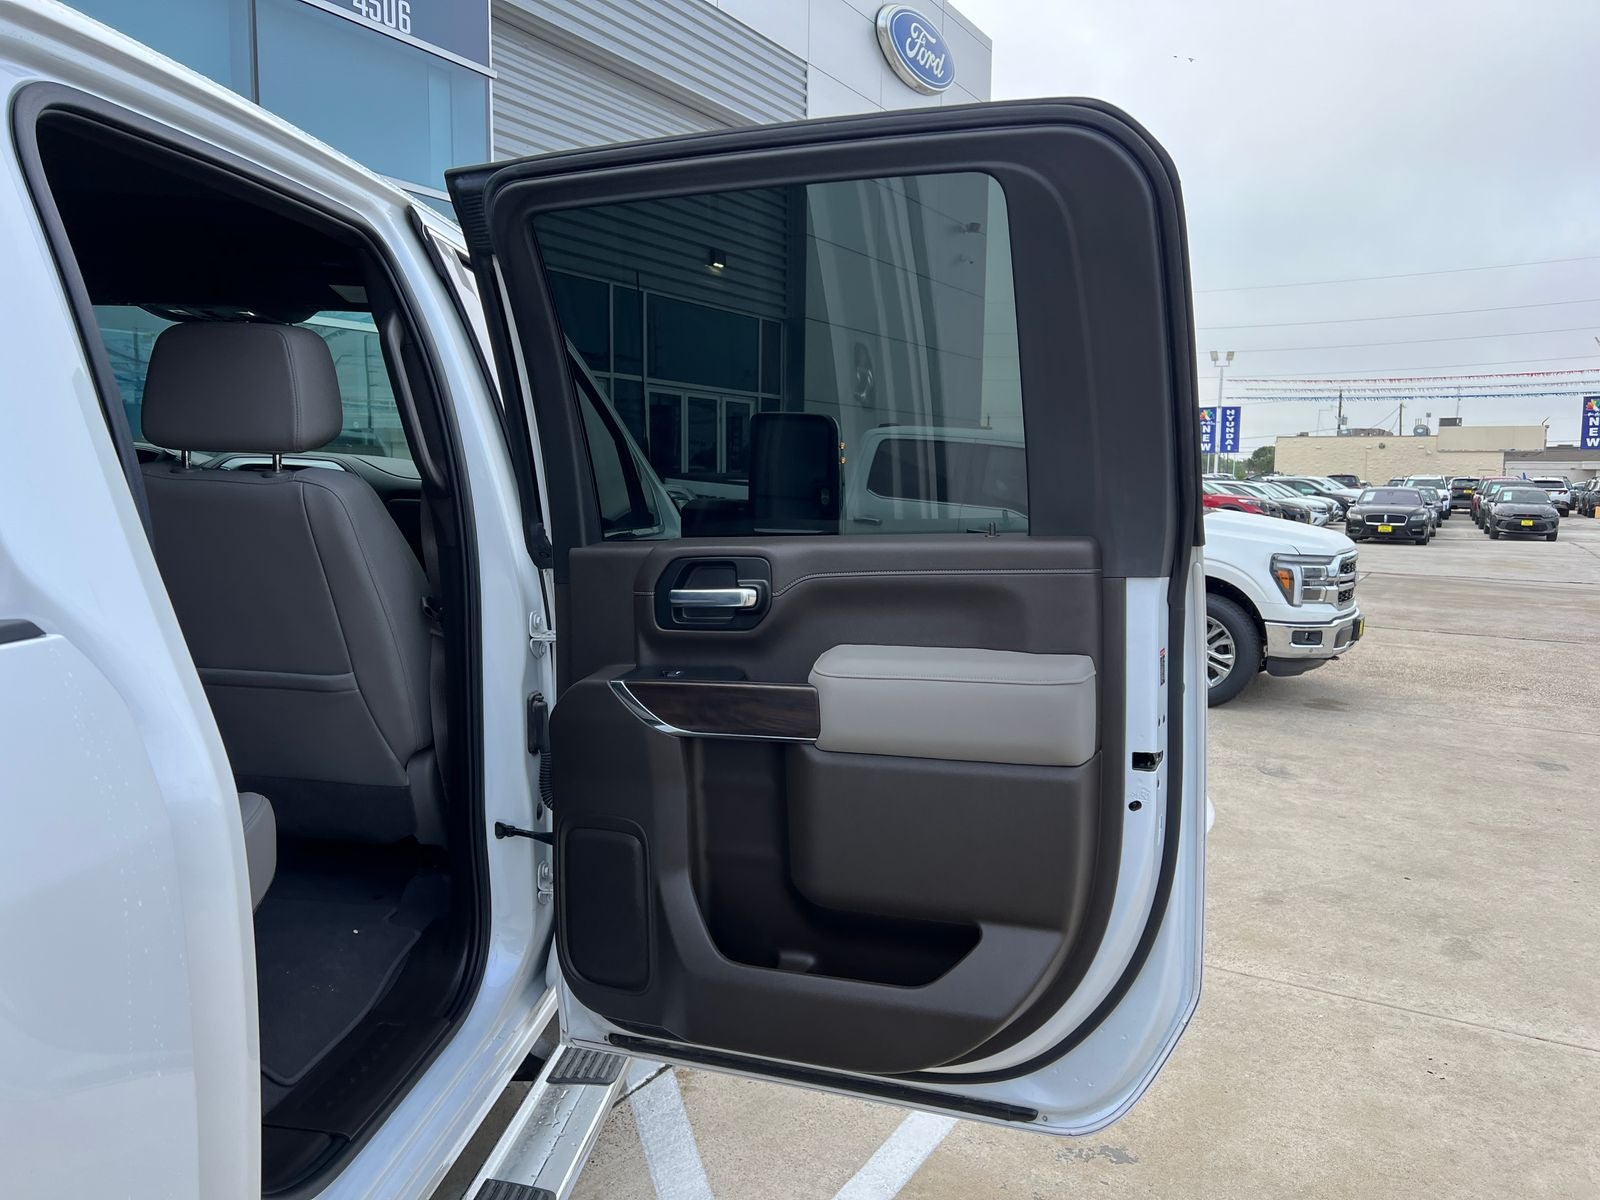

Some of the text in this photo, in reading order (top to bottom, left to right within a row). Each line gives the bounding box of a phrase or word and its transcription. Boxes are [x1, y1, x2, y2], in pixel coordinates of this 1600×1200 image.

[353, 0, 411, 34] 4506
[906, 22, 945, 78] Ford
[1200, 425, 1211, 451] NEW
[1225, 409, 1235, 451] HYUNDAI
[1586, 416, 1600, 447] NEW
